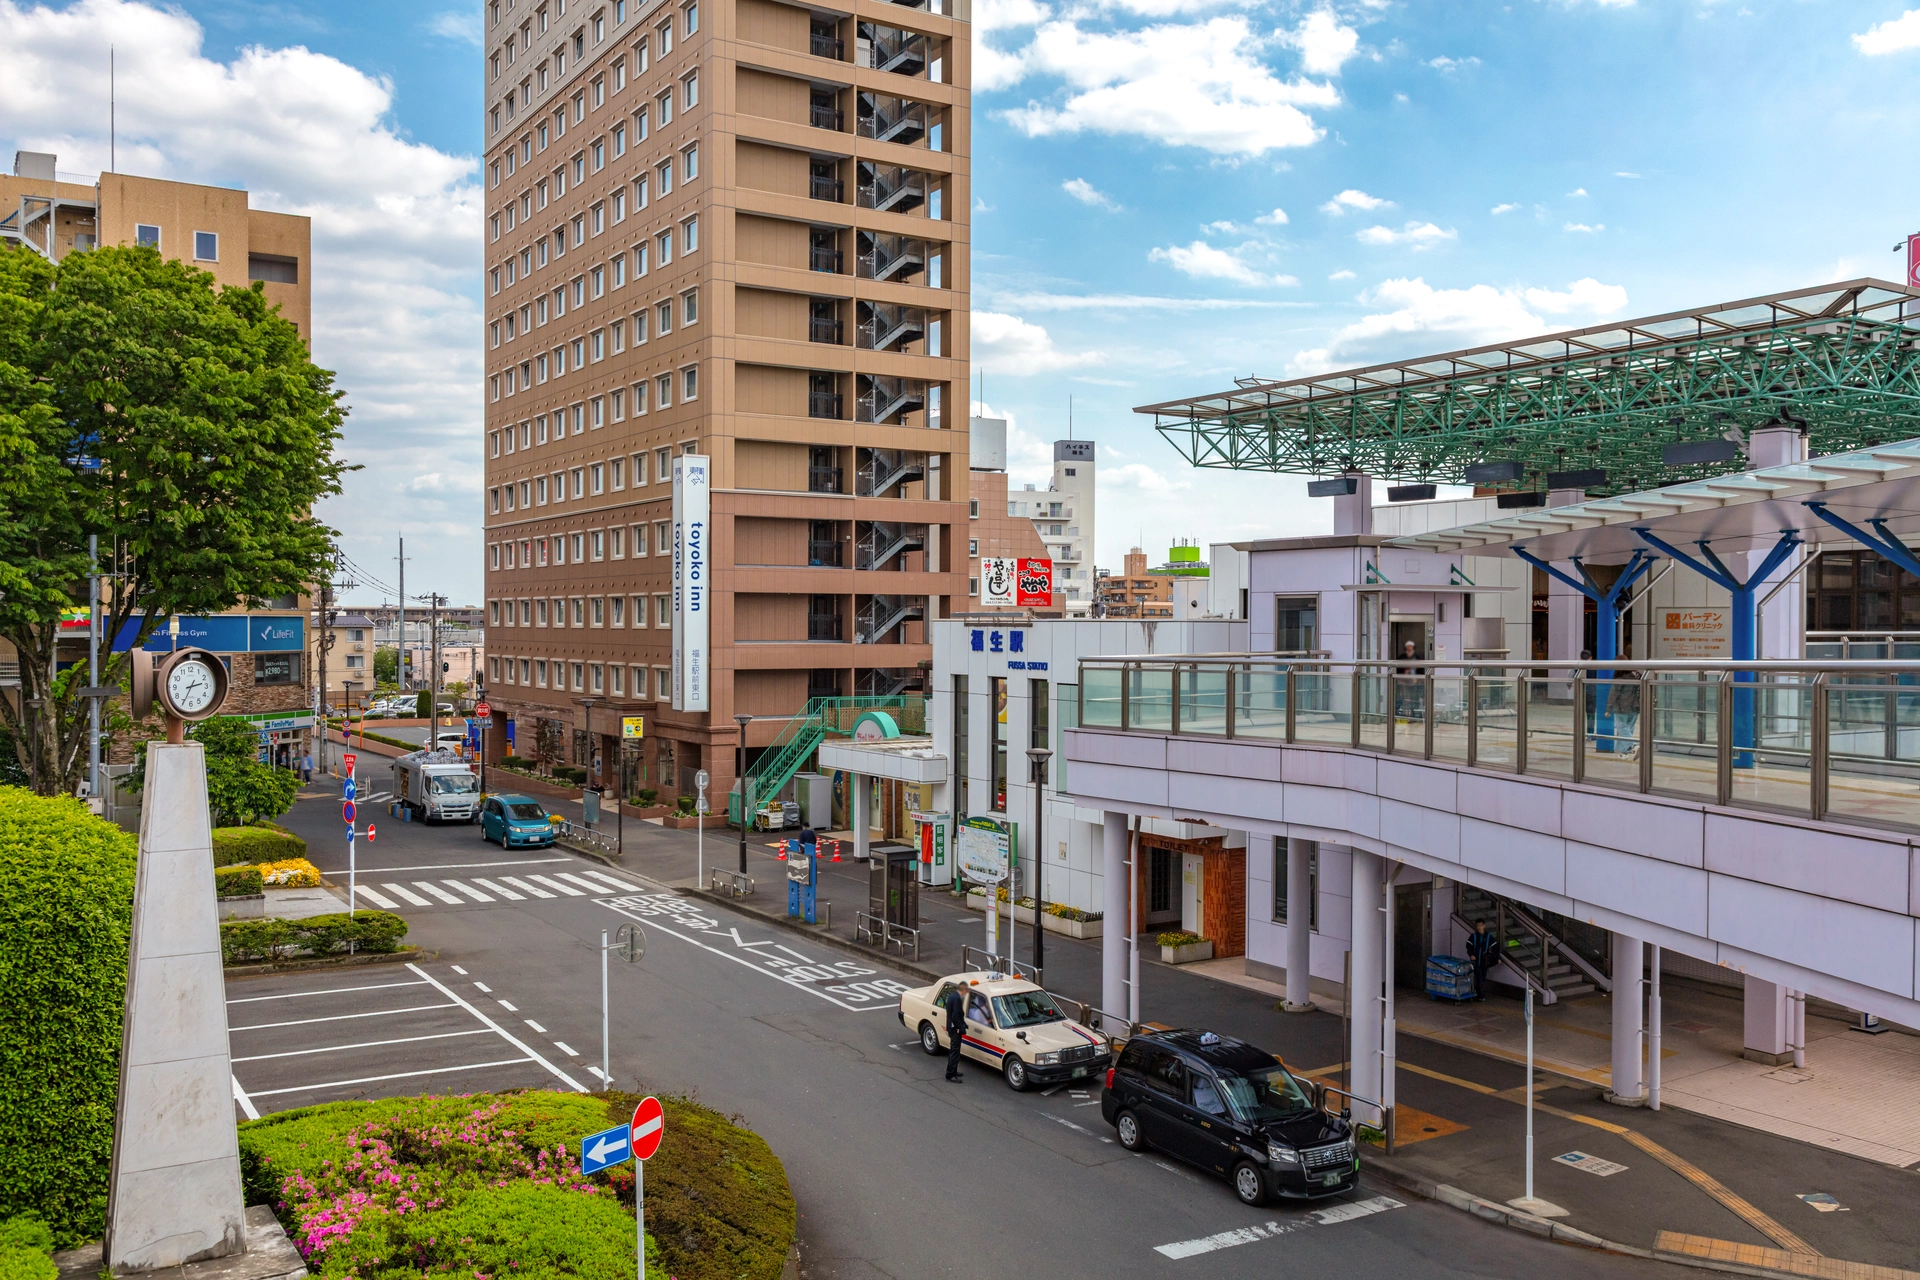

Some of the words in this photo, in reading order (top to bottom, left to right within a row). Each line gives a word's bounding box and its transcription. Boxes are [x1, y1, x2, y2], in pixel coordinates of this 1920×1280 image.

[688, 522, 703, 580] toyoko
[691, 586, 703, 611] inn
[1682, 612, 1722, 621] バーデン
[272, 629, 294, 639] LifeFit
[1428, 626, 1434, 636] 2
[971, 629, 1023, 652] 福生駅
[1008, 661, 1026, 669] FUSSA
[272, 720, 294, 728] FamilyMart
[1160, 841, 1189, 852] TOILET
[628, 902, 703, 916] BUS
[782, 962, 877, 982] STOP
[824, 979, 913, 1002] BUS
